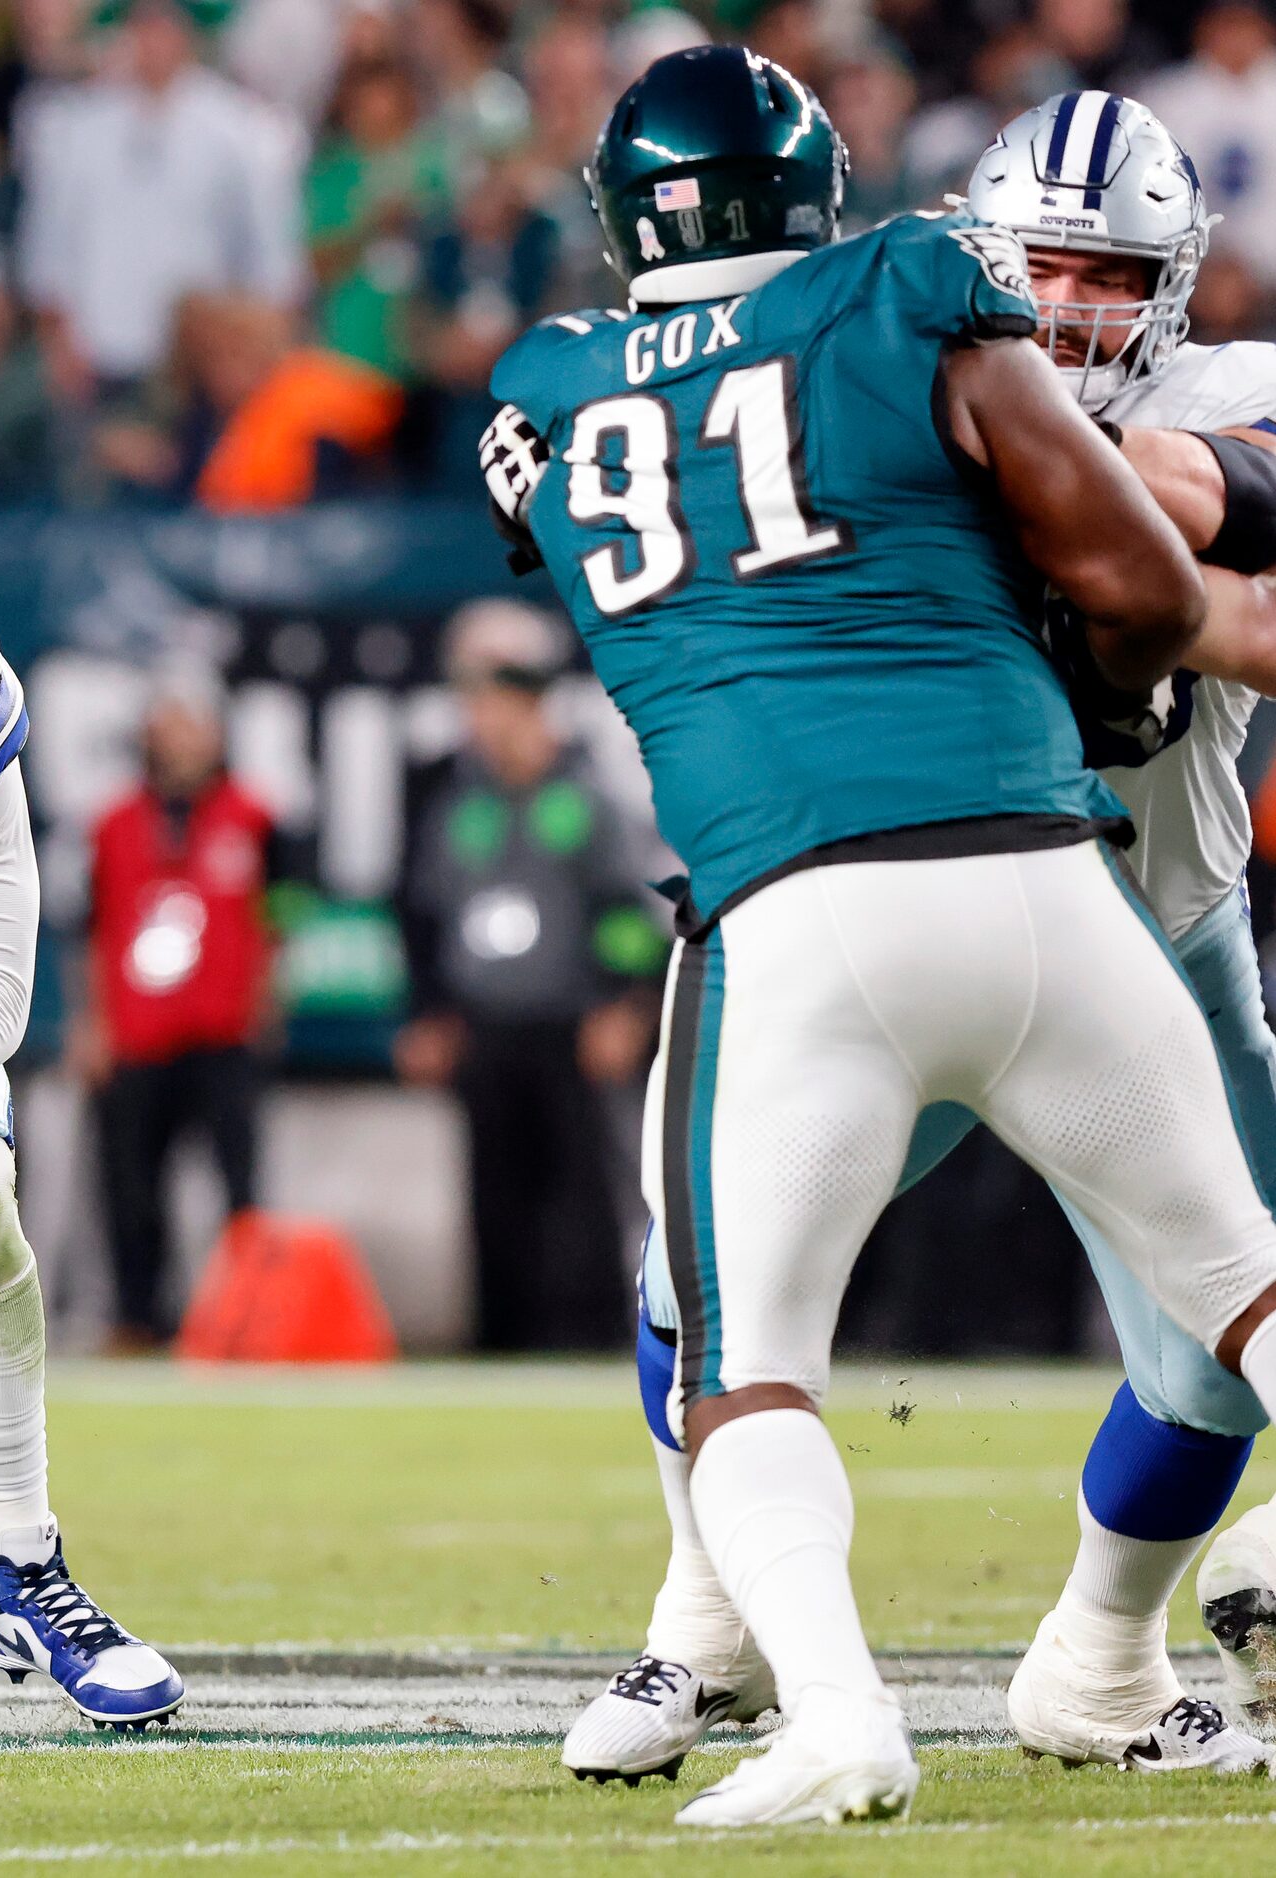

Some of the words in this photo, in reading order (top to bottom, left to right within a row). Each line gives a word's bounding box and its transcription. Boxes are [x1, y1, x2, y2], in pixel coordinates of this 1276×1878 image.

[677, 199, 751, 248] 91
[1039, 216, 1095, 229] COWBOYS
[624, 295, 748, 387] COX
[562, 356, 852, 618] 91
